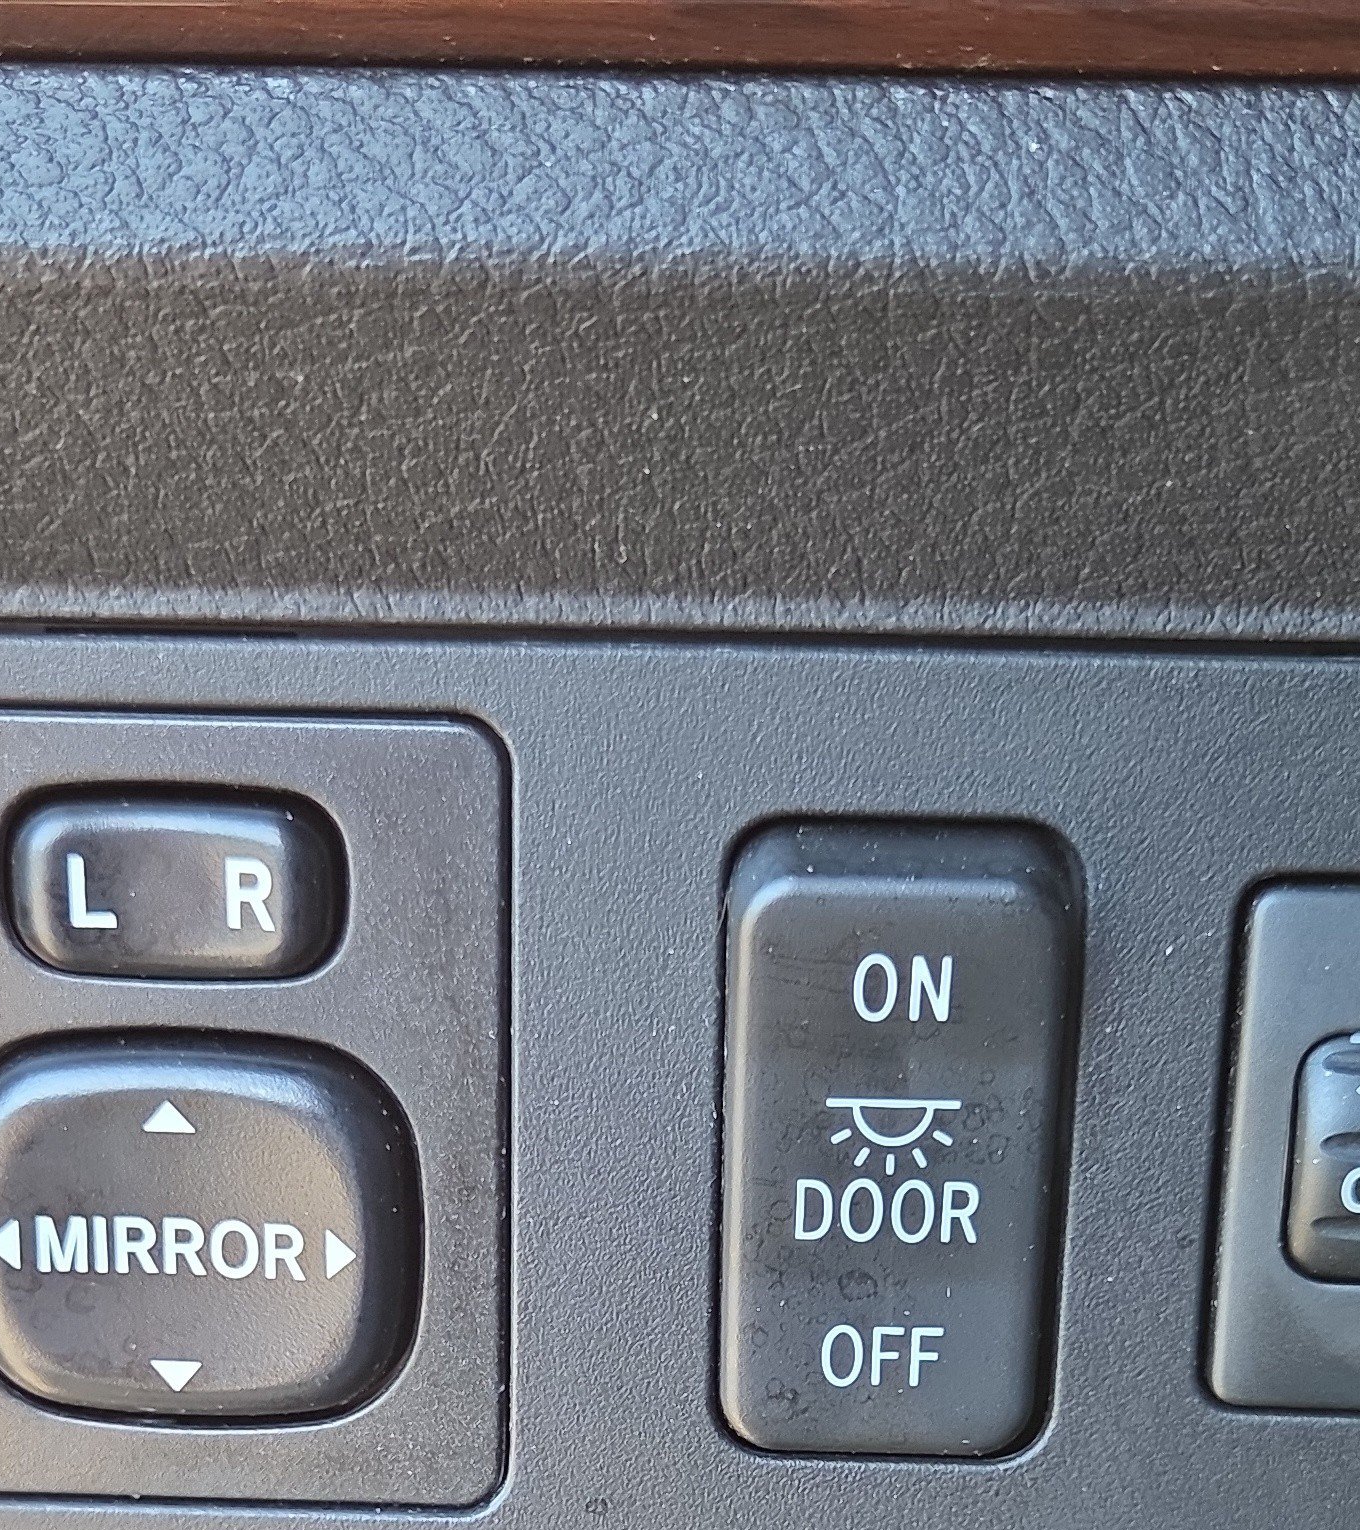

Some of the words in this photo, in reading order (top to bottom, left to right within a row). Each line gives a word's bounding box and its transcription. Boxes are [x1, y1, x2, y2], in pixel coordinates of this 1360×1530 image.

[67, 853, 118, 929] L
[224, 857, 276, 932] R
[852, 952, 954, 1023] ON
[793, 1178, 980, 1245] DOOR
[35, 1215, 307, 1282] MIRROR
[820, 1323, 945, 1388] OFF
